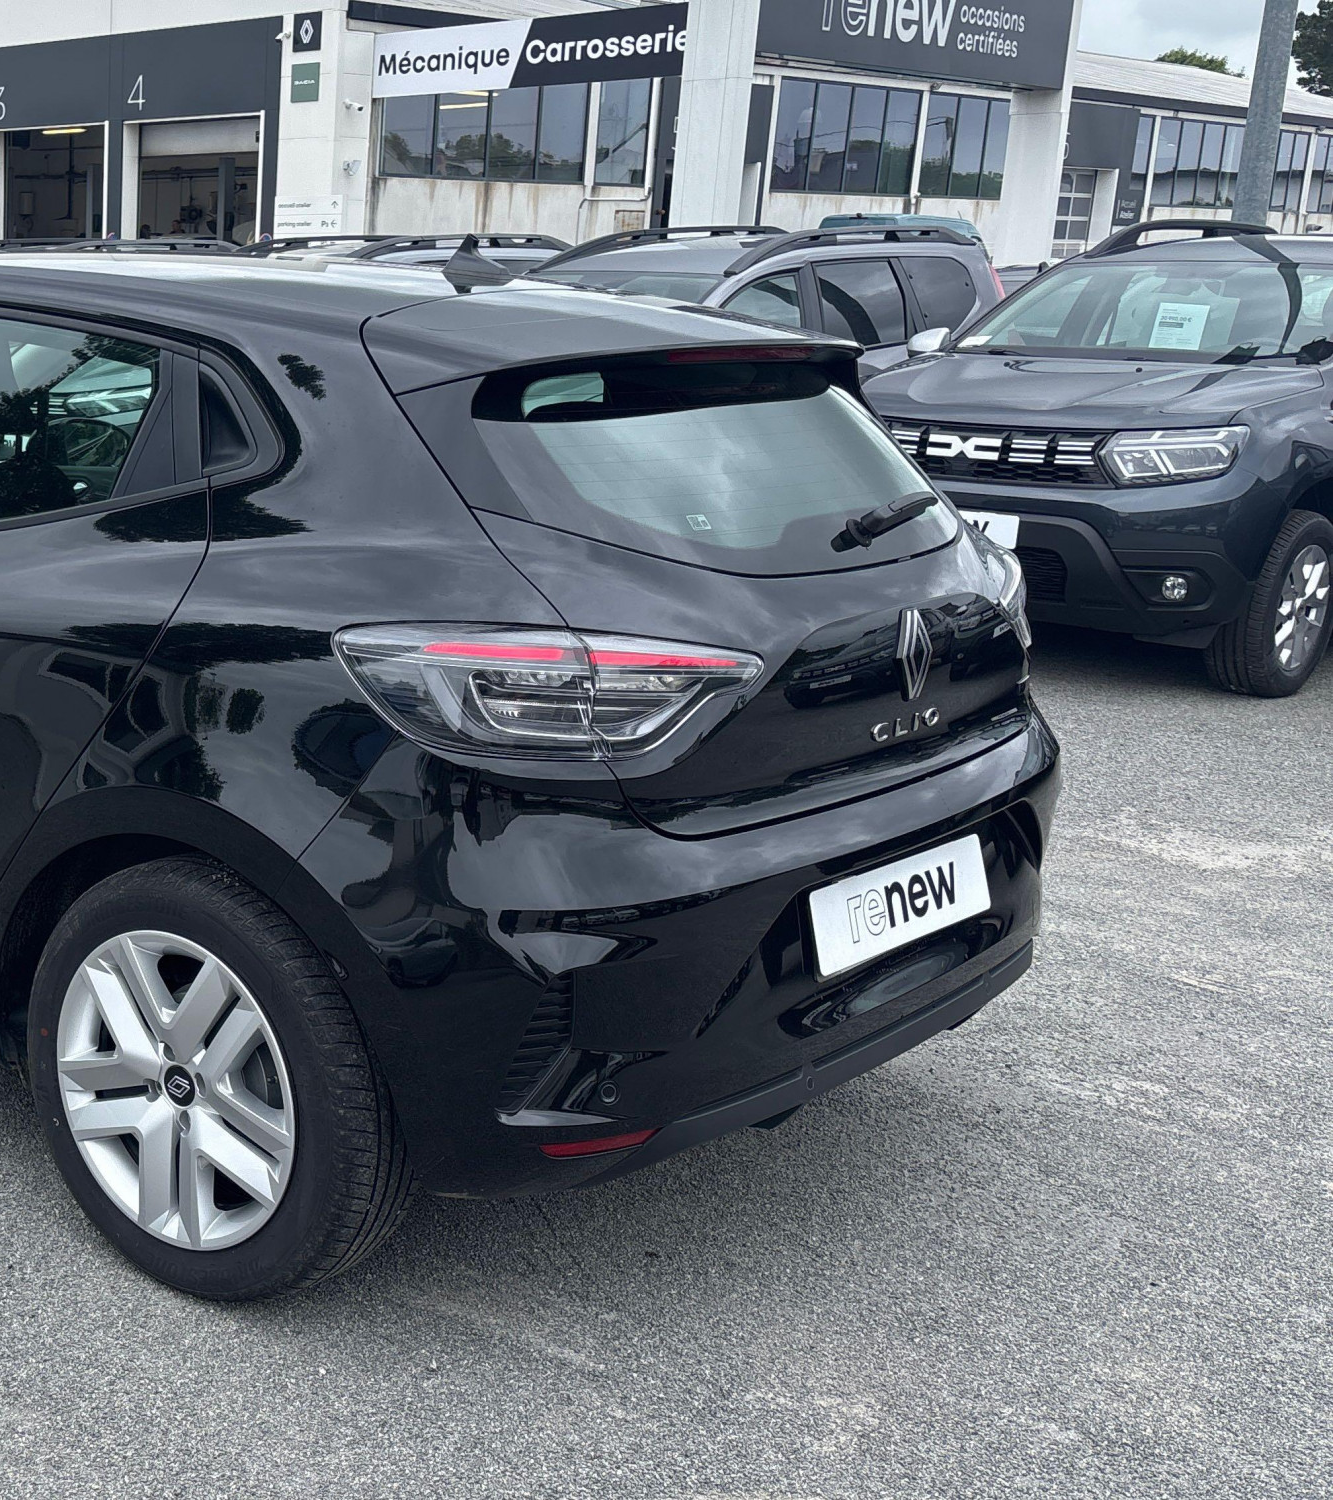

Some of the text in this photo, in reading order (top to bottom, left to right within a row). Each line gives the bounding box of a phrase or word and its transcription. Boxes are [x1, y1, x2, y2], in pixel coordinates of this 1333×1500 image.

[960, 5, 1026, 33] occasions
[378, 24, 687, 76] Mécanique Carrosserie
[957, 31, 1019, 58] certifiées
[127, 74, 146, 111] 4
[870, 707, 940, 742] CLIO
[846, 861, 956, 944] renew
